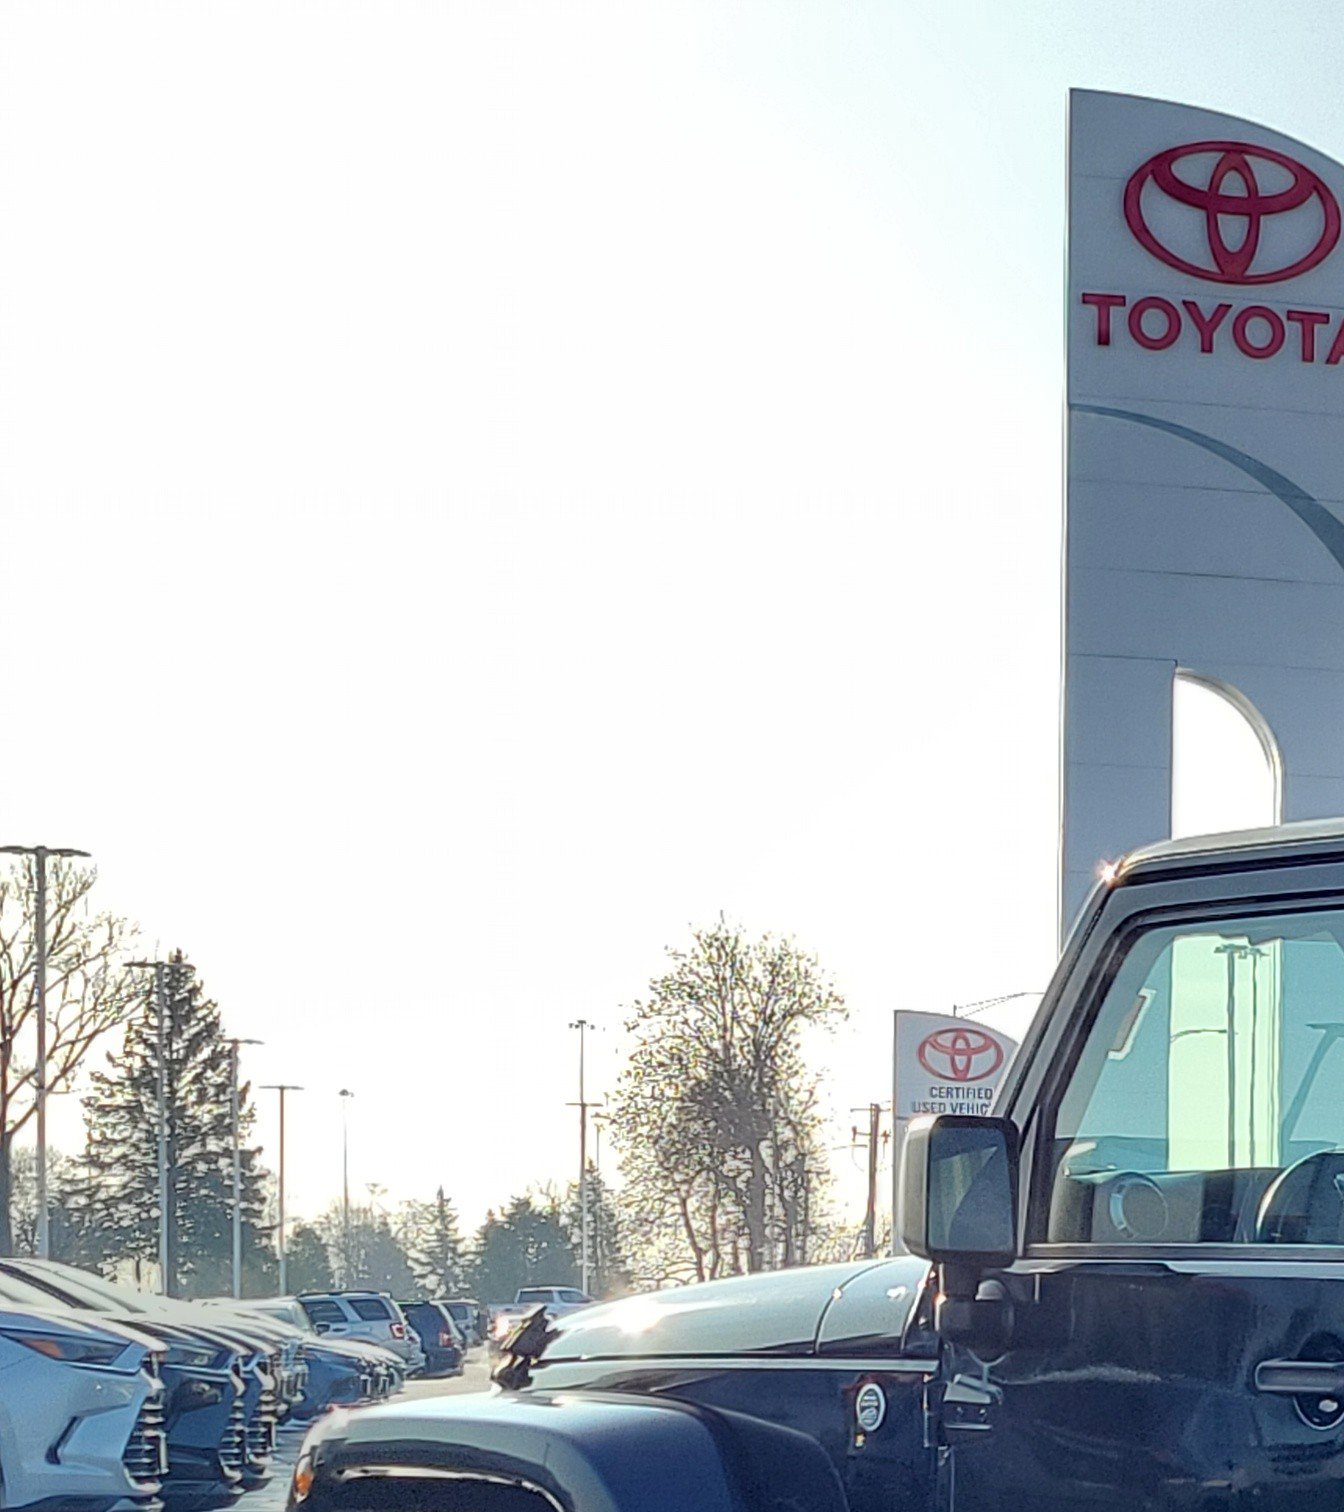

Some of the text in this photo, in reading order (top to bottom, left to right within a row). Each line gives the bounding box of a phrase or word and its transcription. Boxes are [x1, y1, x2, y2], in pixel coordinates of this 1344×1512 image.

[929, 1086, 993, 1100] CERTIFIED
[912, 1102, 991, 1115] USED VEHIC
